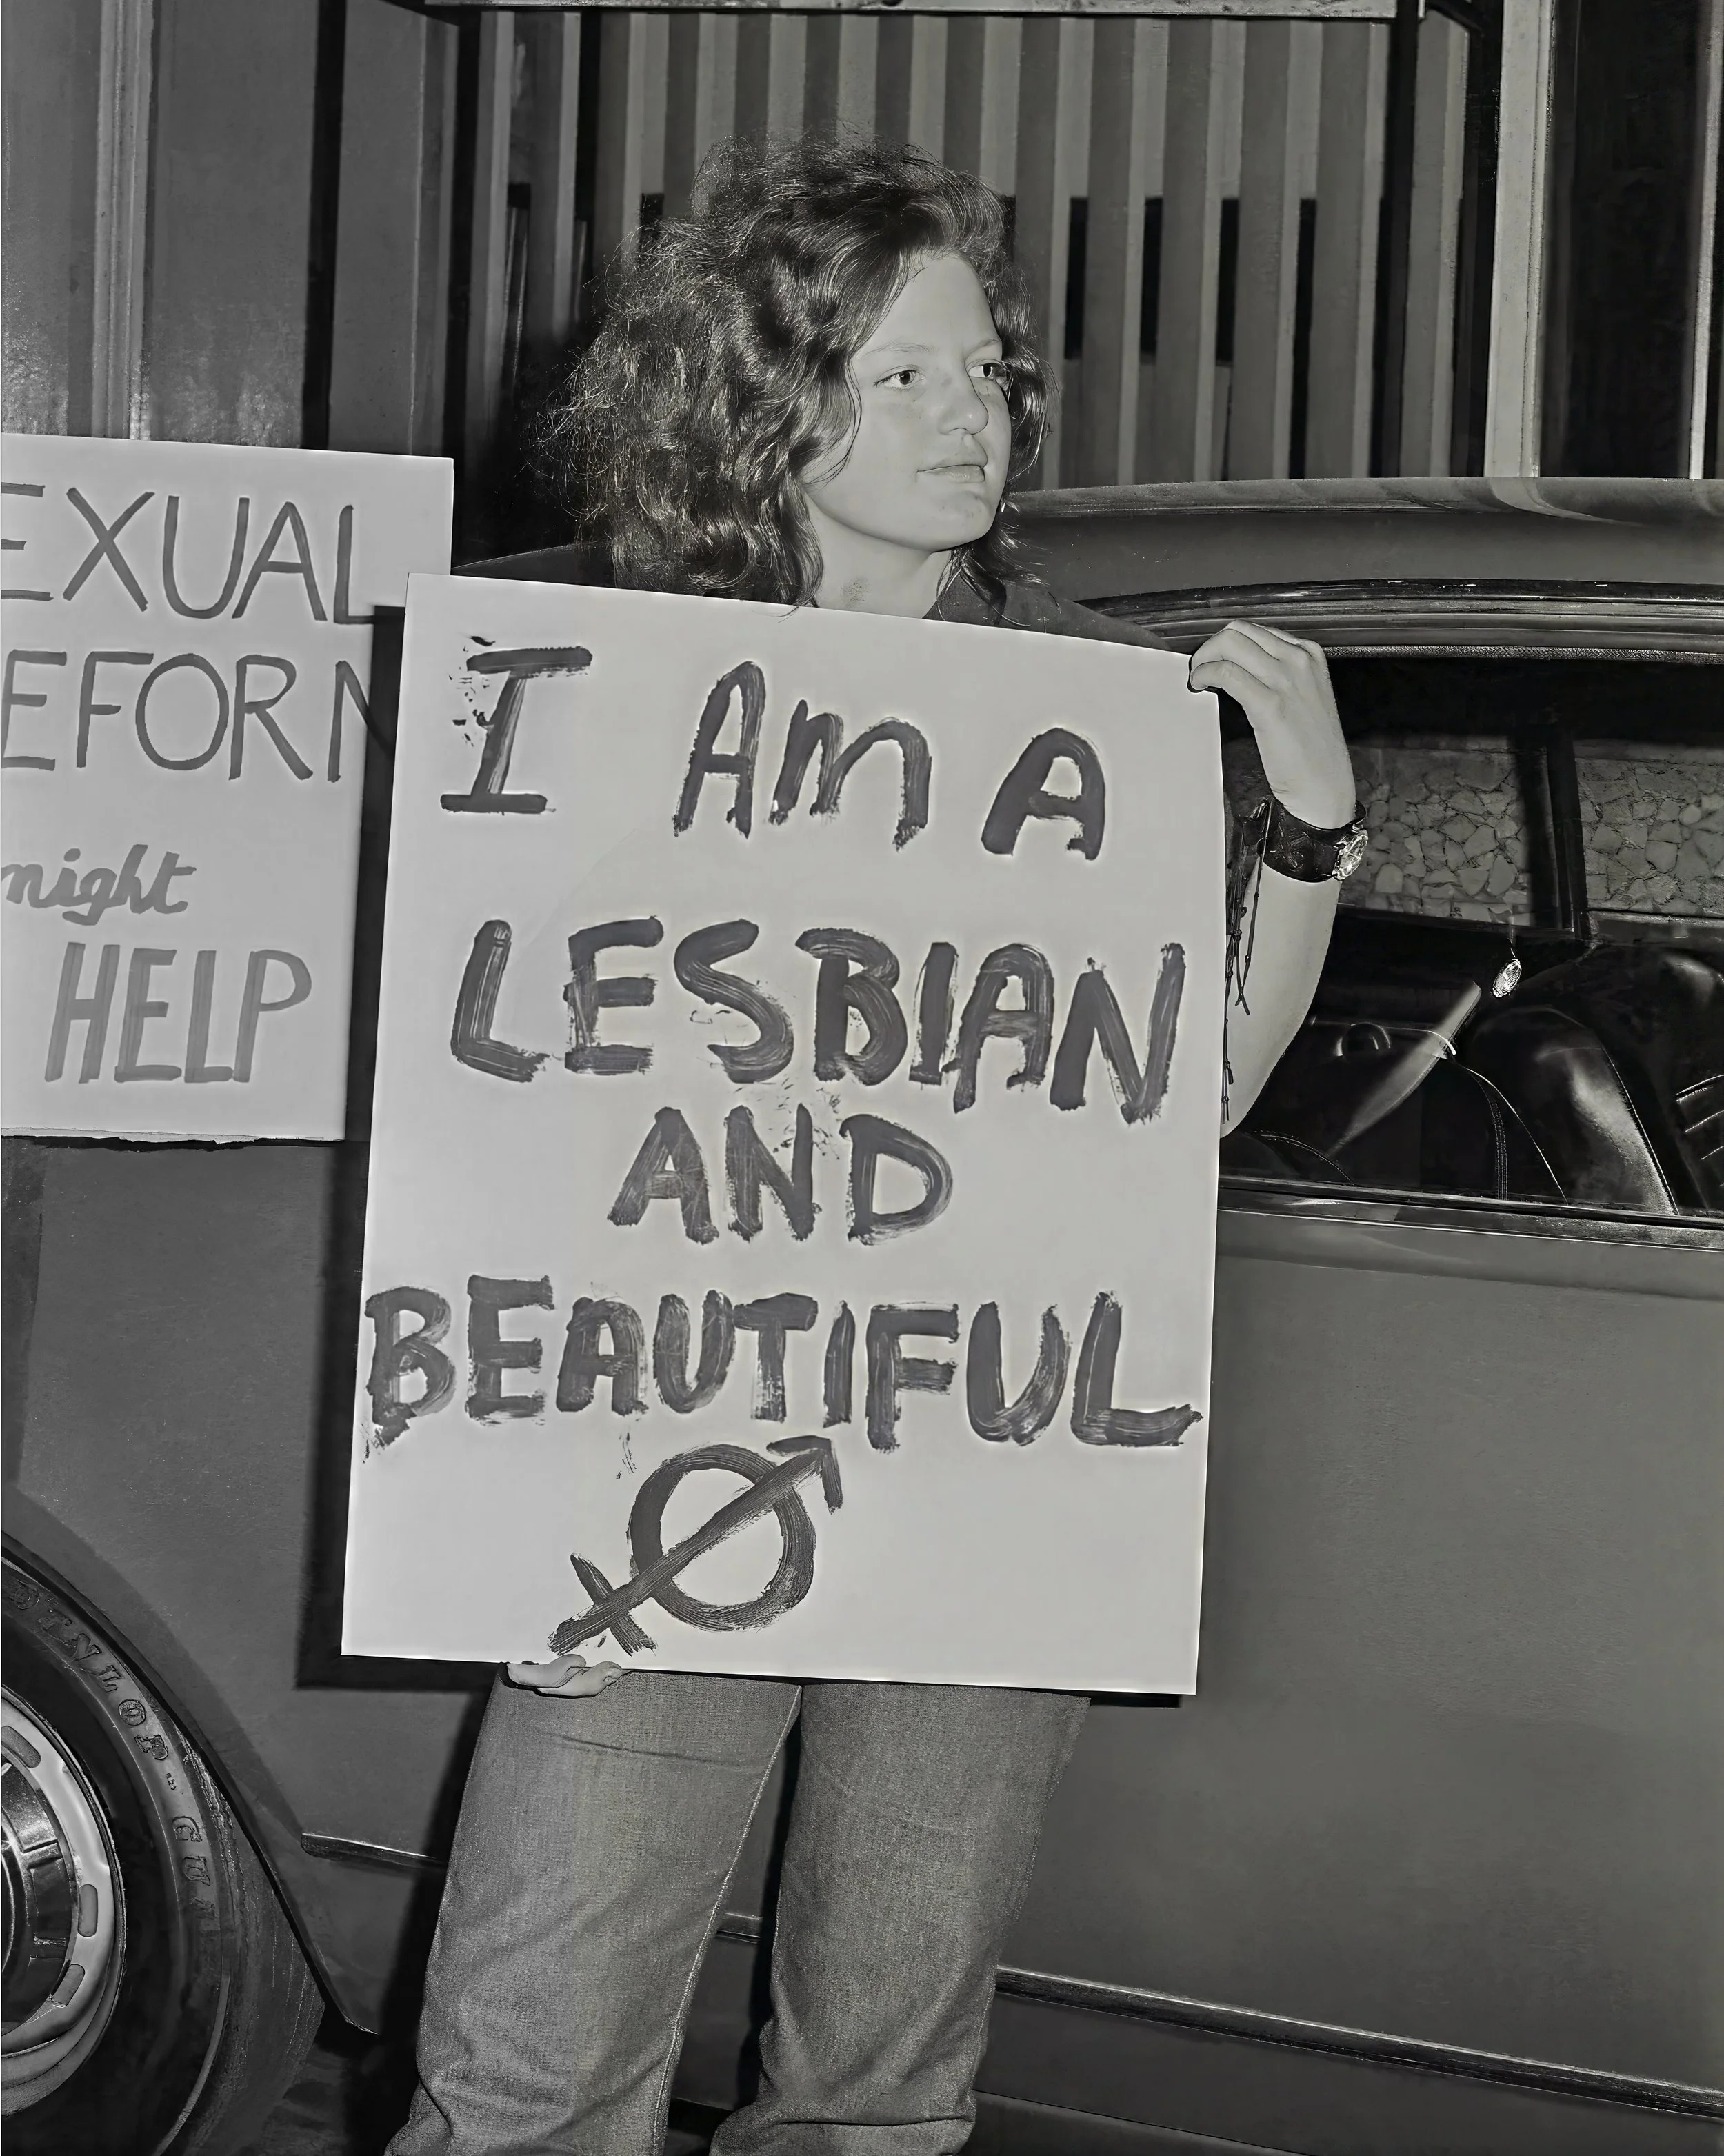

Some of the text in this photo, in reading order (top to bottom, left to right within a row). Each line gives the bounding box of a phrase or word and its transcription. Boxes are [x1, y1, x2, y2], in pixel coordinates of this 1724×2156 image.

[440, 646, 594, 814] I
[981, 727, 1107, 861] A
[44, 941, 312, 1084] HELP
[450, 915, 1187, 1126] LESBIAN
[606, 1102, 954, 1246] AND
[363, 1274, 1204, 1455] BEAUTIFUL
